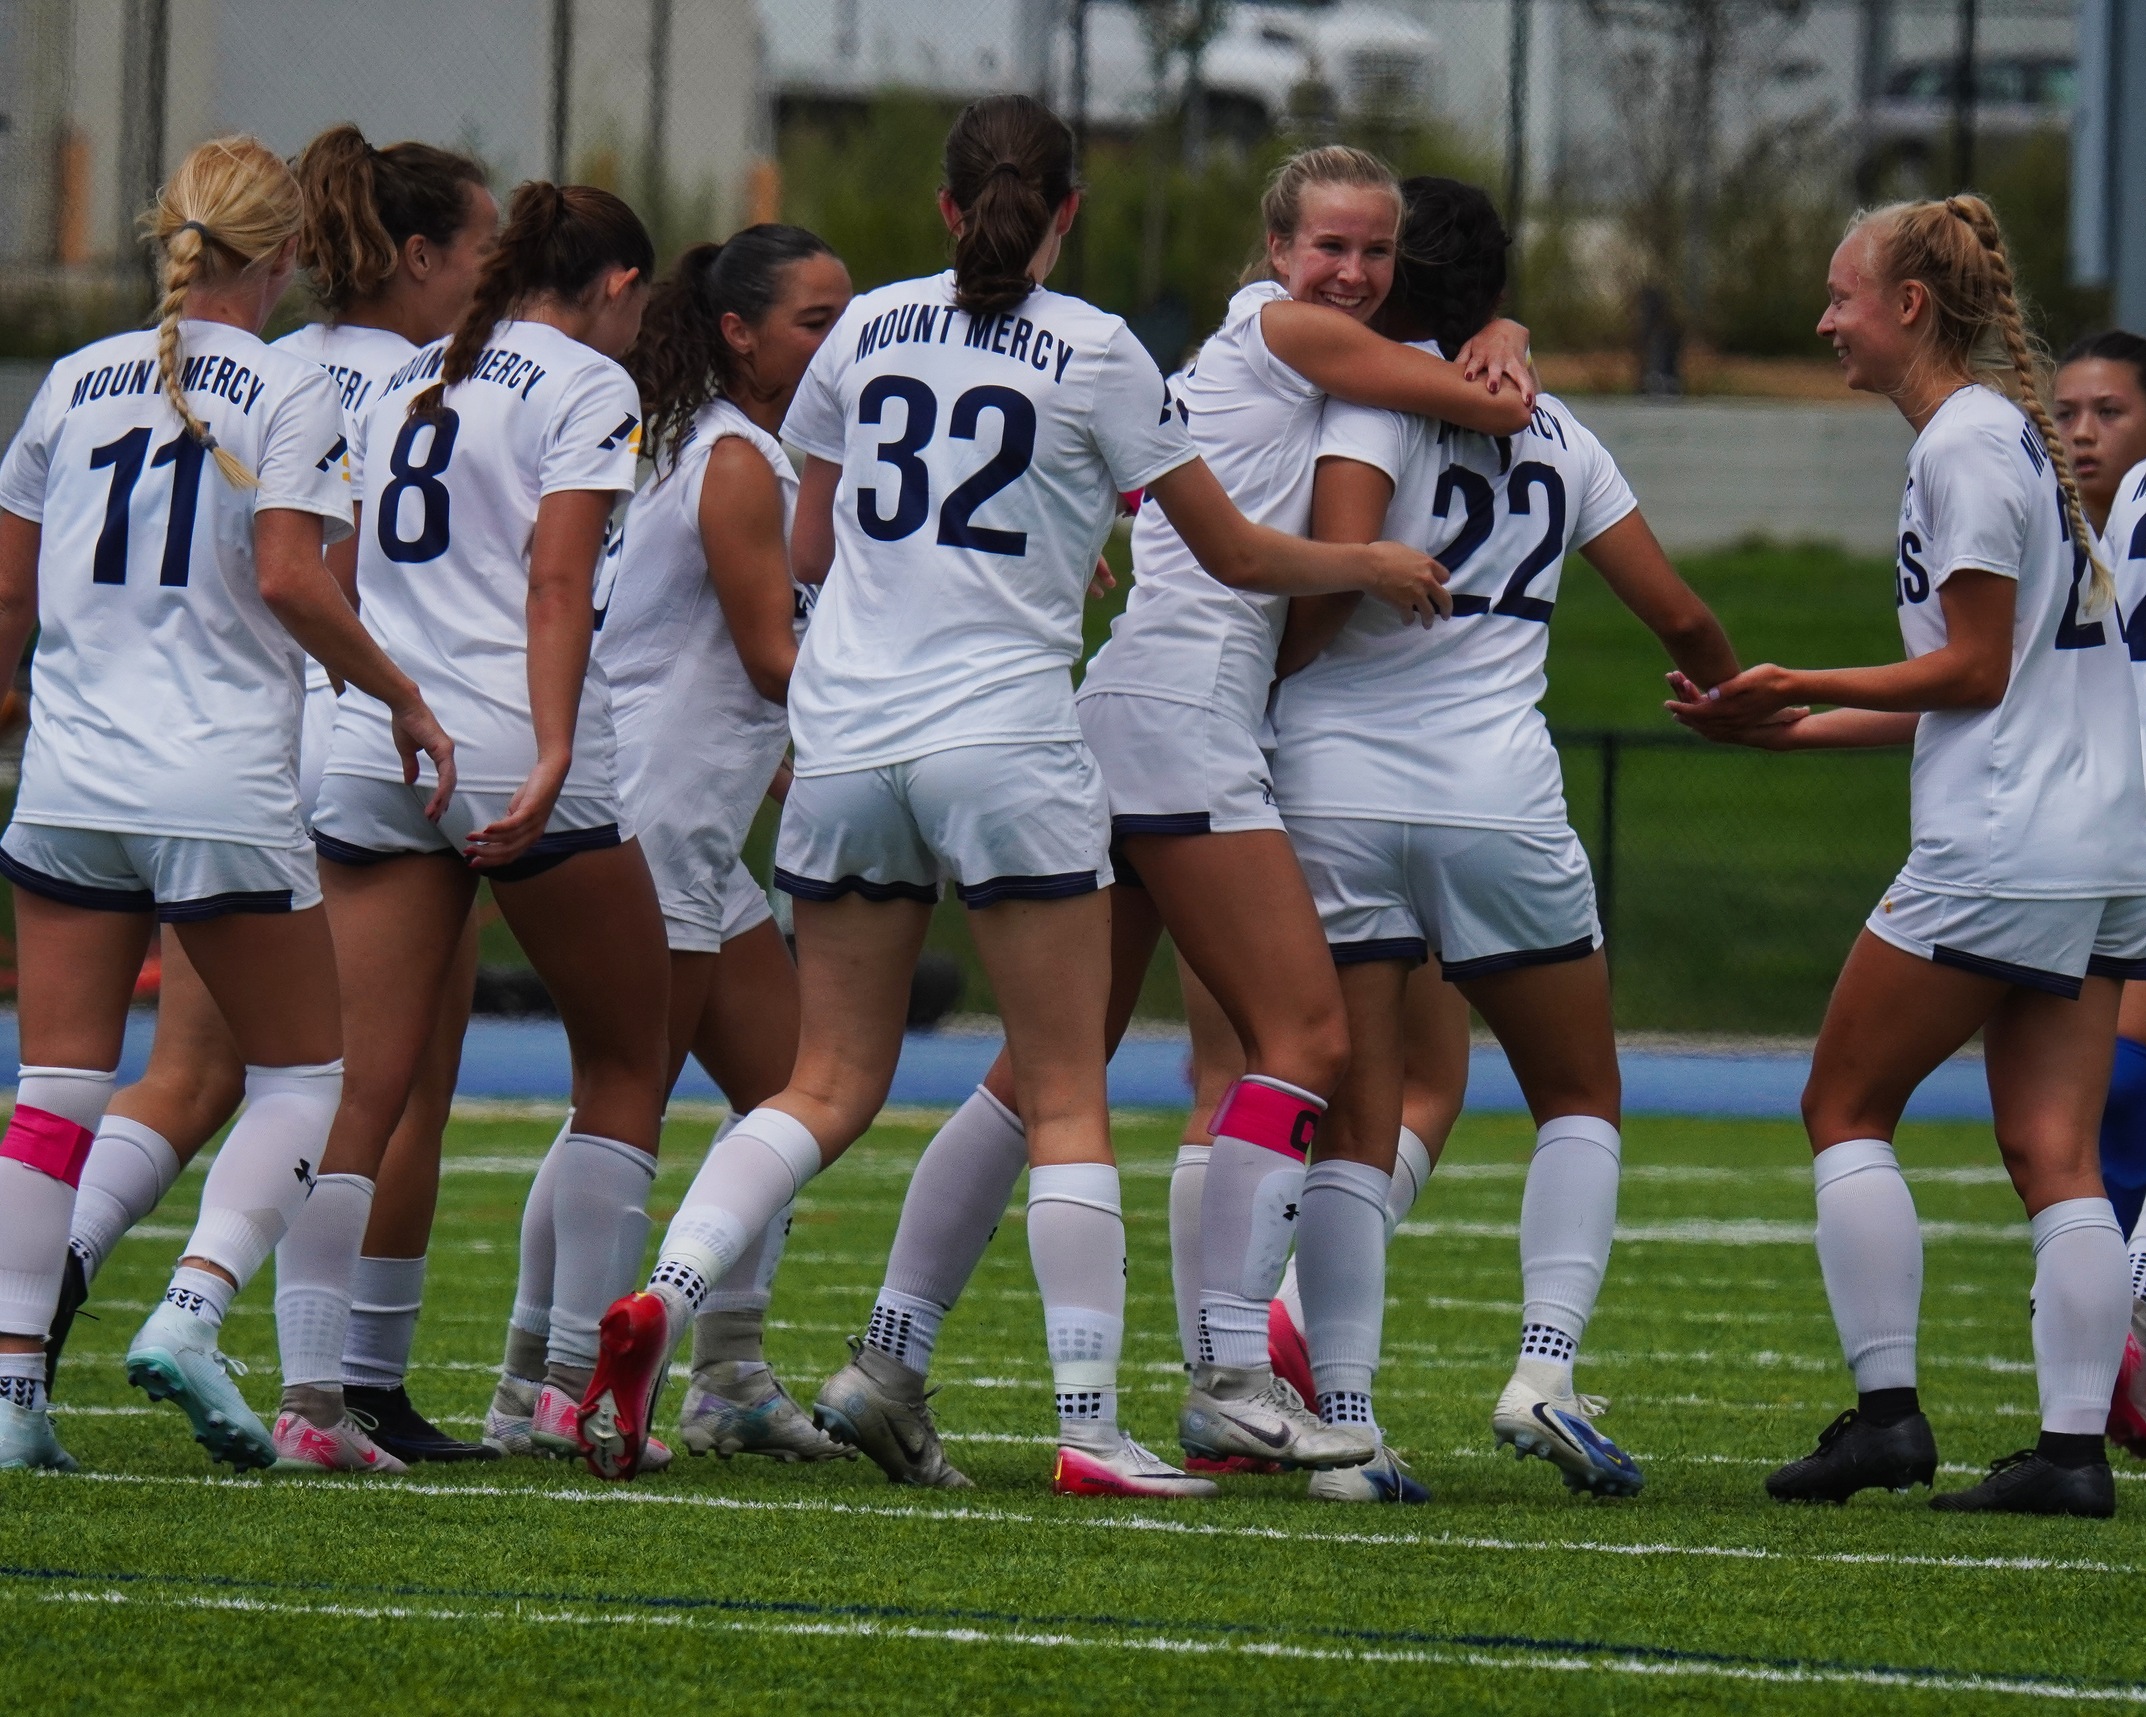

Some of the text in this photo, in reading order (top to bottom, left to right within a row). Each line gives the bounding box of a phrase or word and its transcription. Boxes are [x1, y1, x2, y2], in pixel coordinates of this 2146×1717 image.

[180, 356, 265, 416] MERCY
[376, 346, 446, 402] MOUN
[855, 303, 1074, 385] MOUNT MERCY
[90, 421, 211, 587] 11
[377, 406, 460, 564] 8
[857, 374, 1037, 557] 32
[1416, 460, 1567, 625] 22
